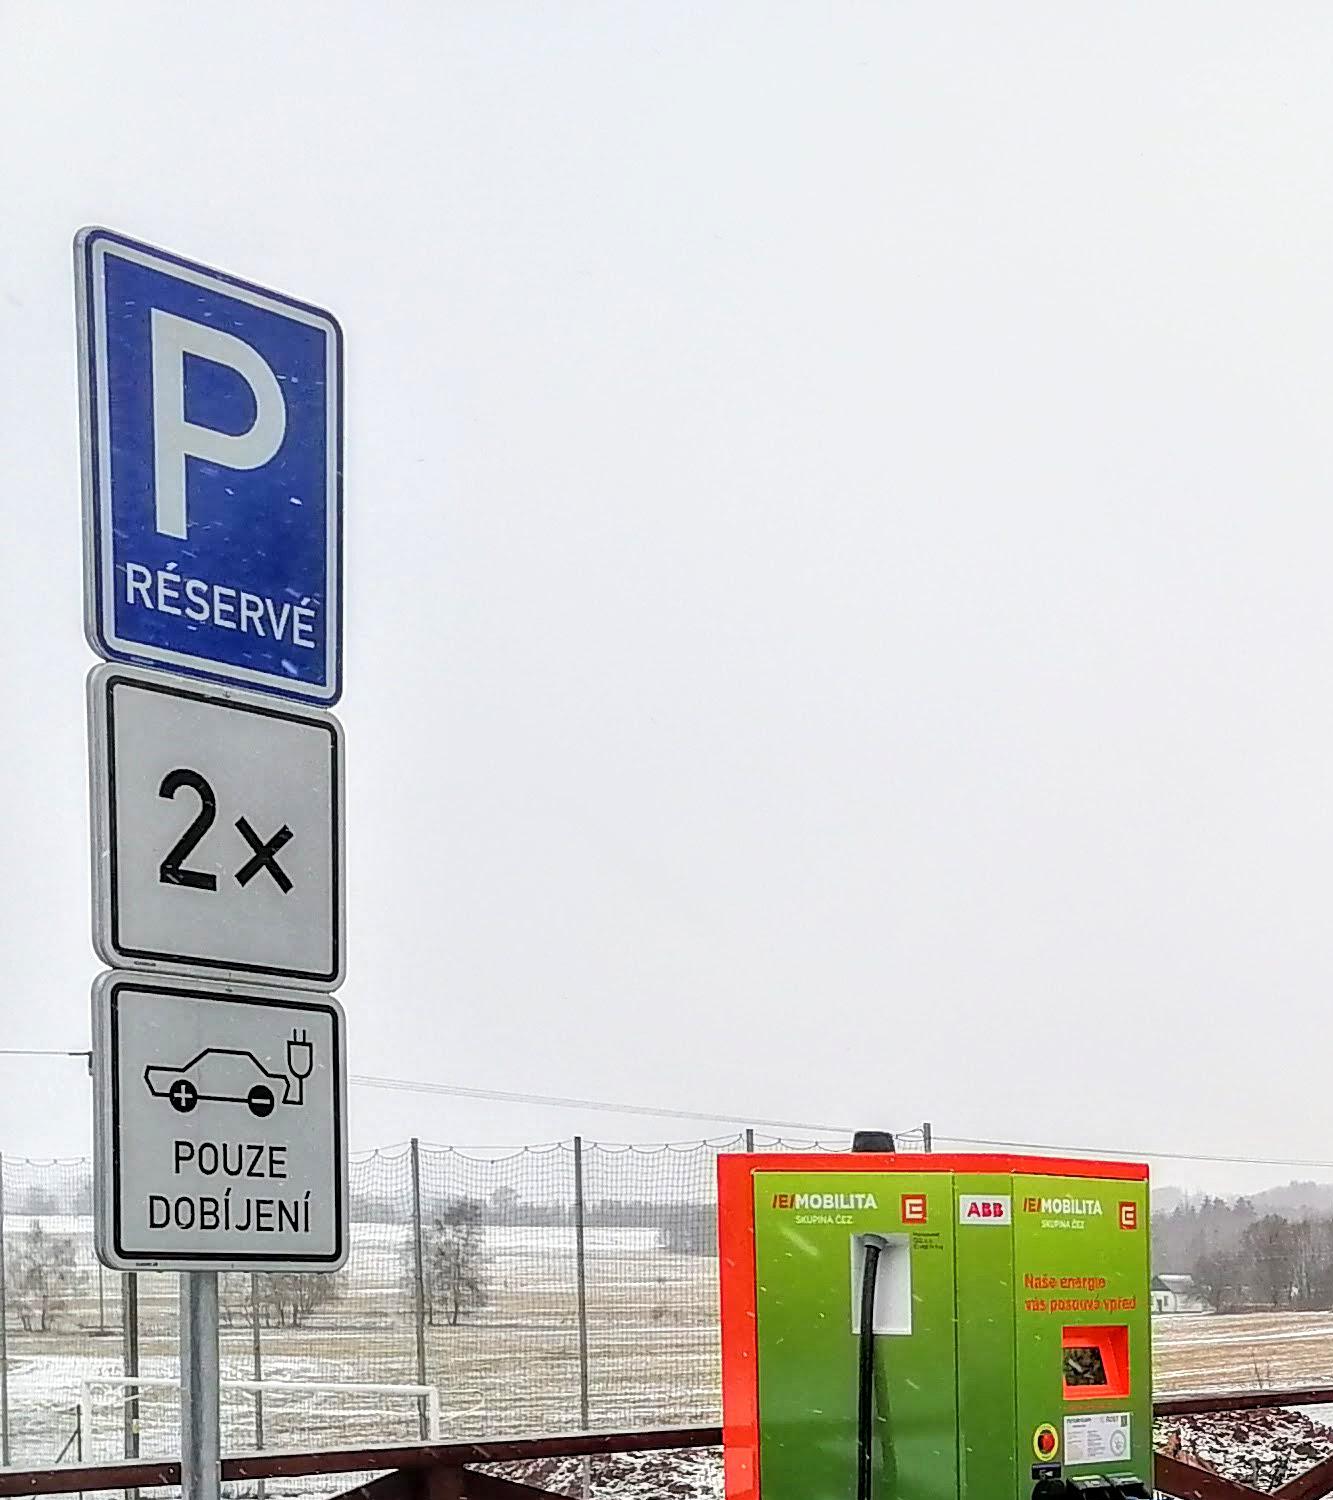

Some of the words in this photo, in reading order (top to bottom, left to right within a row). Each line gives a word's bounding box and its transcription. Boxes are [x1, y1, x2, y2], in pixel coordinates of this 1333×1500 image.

[151, 308, 286, 540] P
[126, 561, 316, 648] RÉSERVÉ
[174, 1140, 287, 1178] POUZE
[149, 1187, 311, 1232] DOBÍJENÍ
[795, 1215, 833, 1225] SKUPINA
[967, 1202, 1004, 1218] ABB
